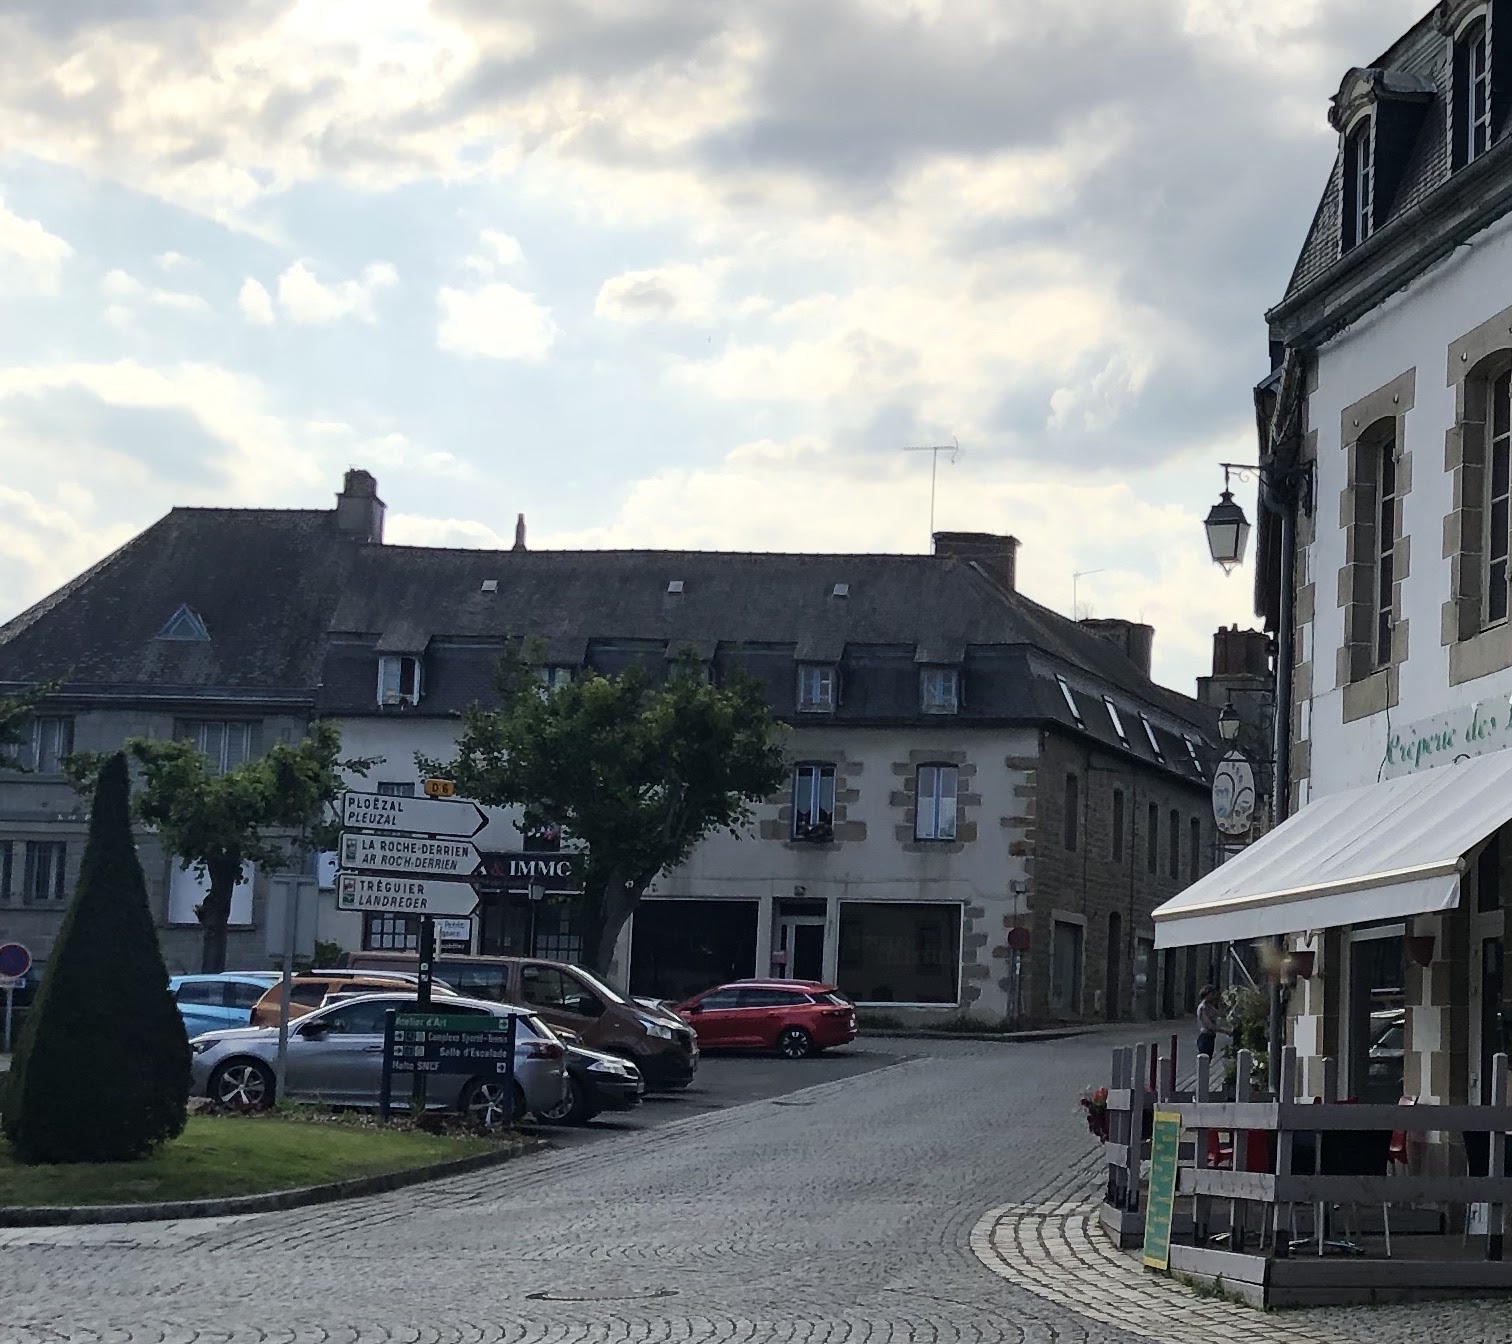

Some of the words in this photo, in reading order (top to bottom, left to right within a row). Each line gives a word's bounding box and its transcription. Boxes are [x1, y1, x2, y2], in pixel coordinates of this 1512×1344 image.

[1465, 708, 1497, 743] des
[432, 783, 439, 793] D
[442, 784, 449, 793] 6
[348, 796, 404, 812] PLOËZAL
[347, 812, 397, 826] PLEUZAL
[361, 839, 375, 851] LA
[380, 841, 469, 857] ROCHE-DERRIEN
[362, 855, 377, 865] AR
[359, 879, 424, 895] TRÉGUIER
[358, 895, 428, 909] LANDREGER
[439, 1047, 461, 1057] Salle
[416, 1061, 440, 1071] SNCF
